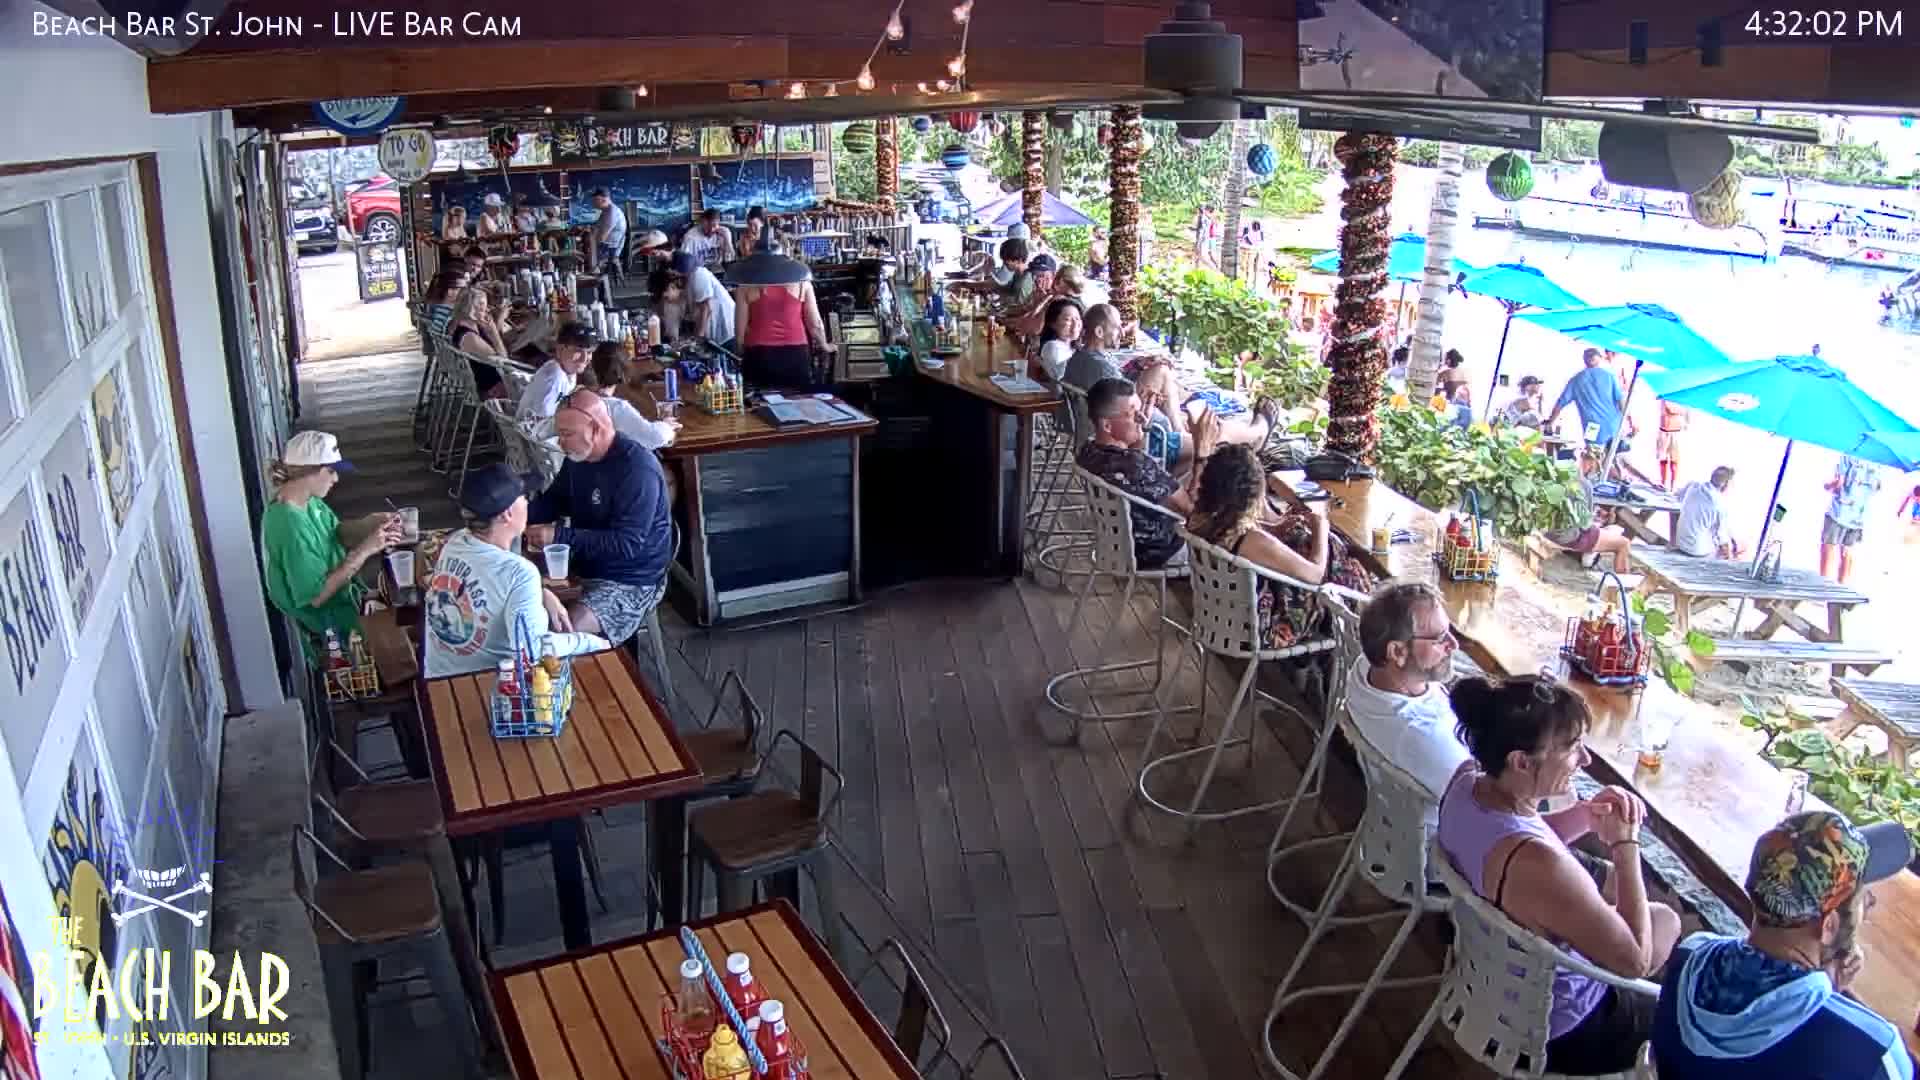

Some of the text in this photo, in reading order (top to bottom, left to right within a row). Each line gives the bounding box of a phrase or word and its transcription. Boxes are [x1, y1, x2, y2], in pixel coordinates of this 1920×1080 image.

[386, 132, 426, 156] TO GO
[637, 127, 669, 146] BAR
[48, 472, 87, 593] BAR
